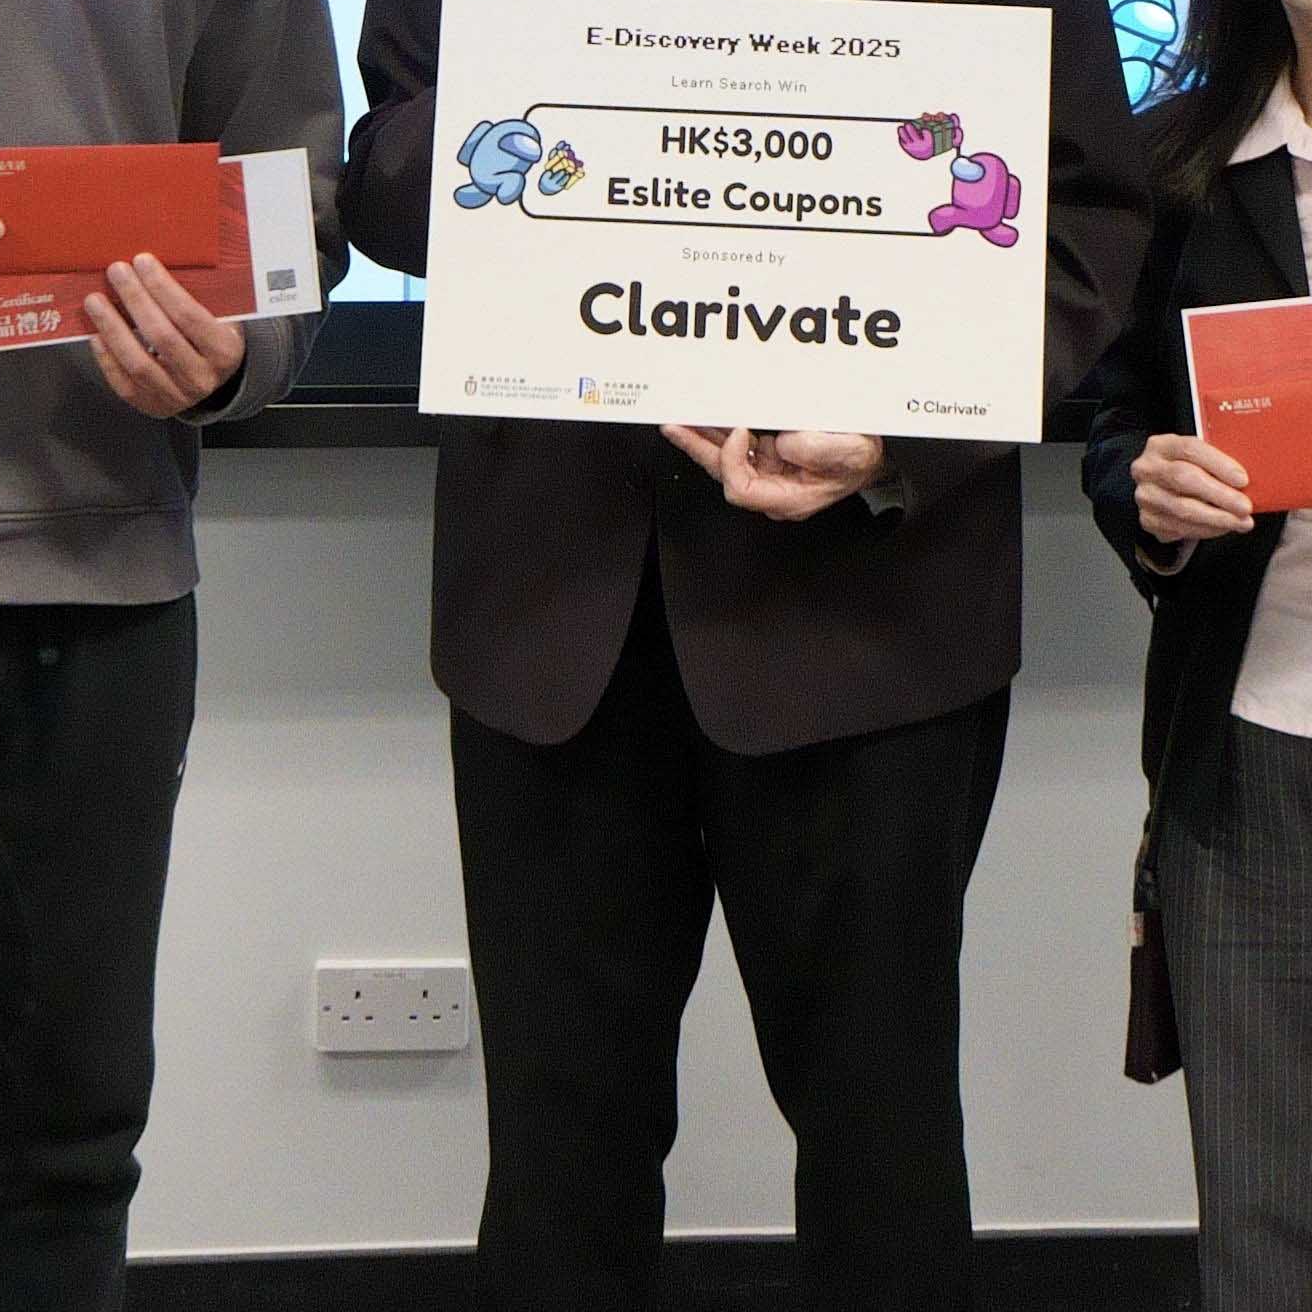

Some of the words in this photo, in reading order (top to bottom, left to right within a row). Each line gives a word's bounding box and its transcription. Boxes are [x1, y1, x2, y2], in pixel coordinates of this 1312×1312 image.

[586, 25, 740, 56] E-Discovery
[748, 32, 821, 56] Week
[830, 35, 903, 60] 2025
[670, 74, 715, 91] Learn
[718, 75, 773, 94] Search
[776, 79, 809, 95] Win
[660, 124, 834, 164] HK$3,000
[606, 175, 711, 211] Eslite
[721, 181, 884, 222] Coupons
[681, 246, 764, 266] Sponsored
[769, 251, 787, 268] by
[578, 280, 903, 350] Clarivate
[923, 399, 988, 417] Clarivate
